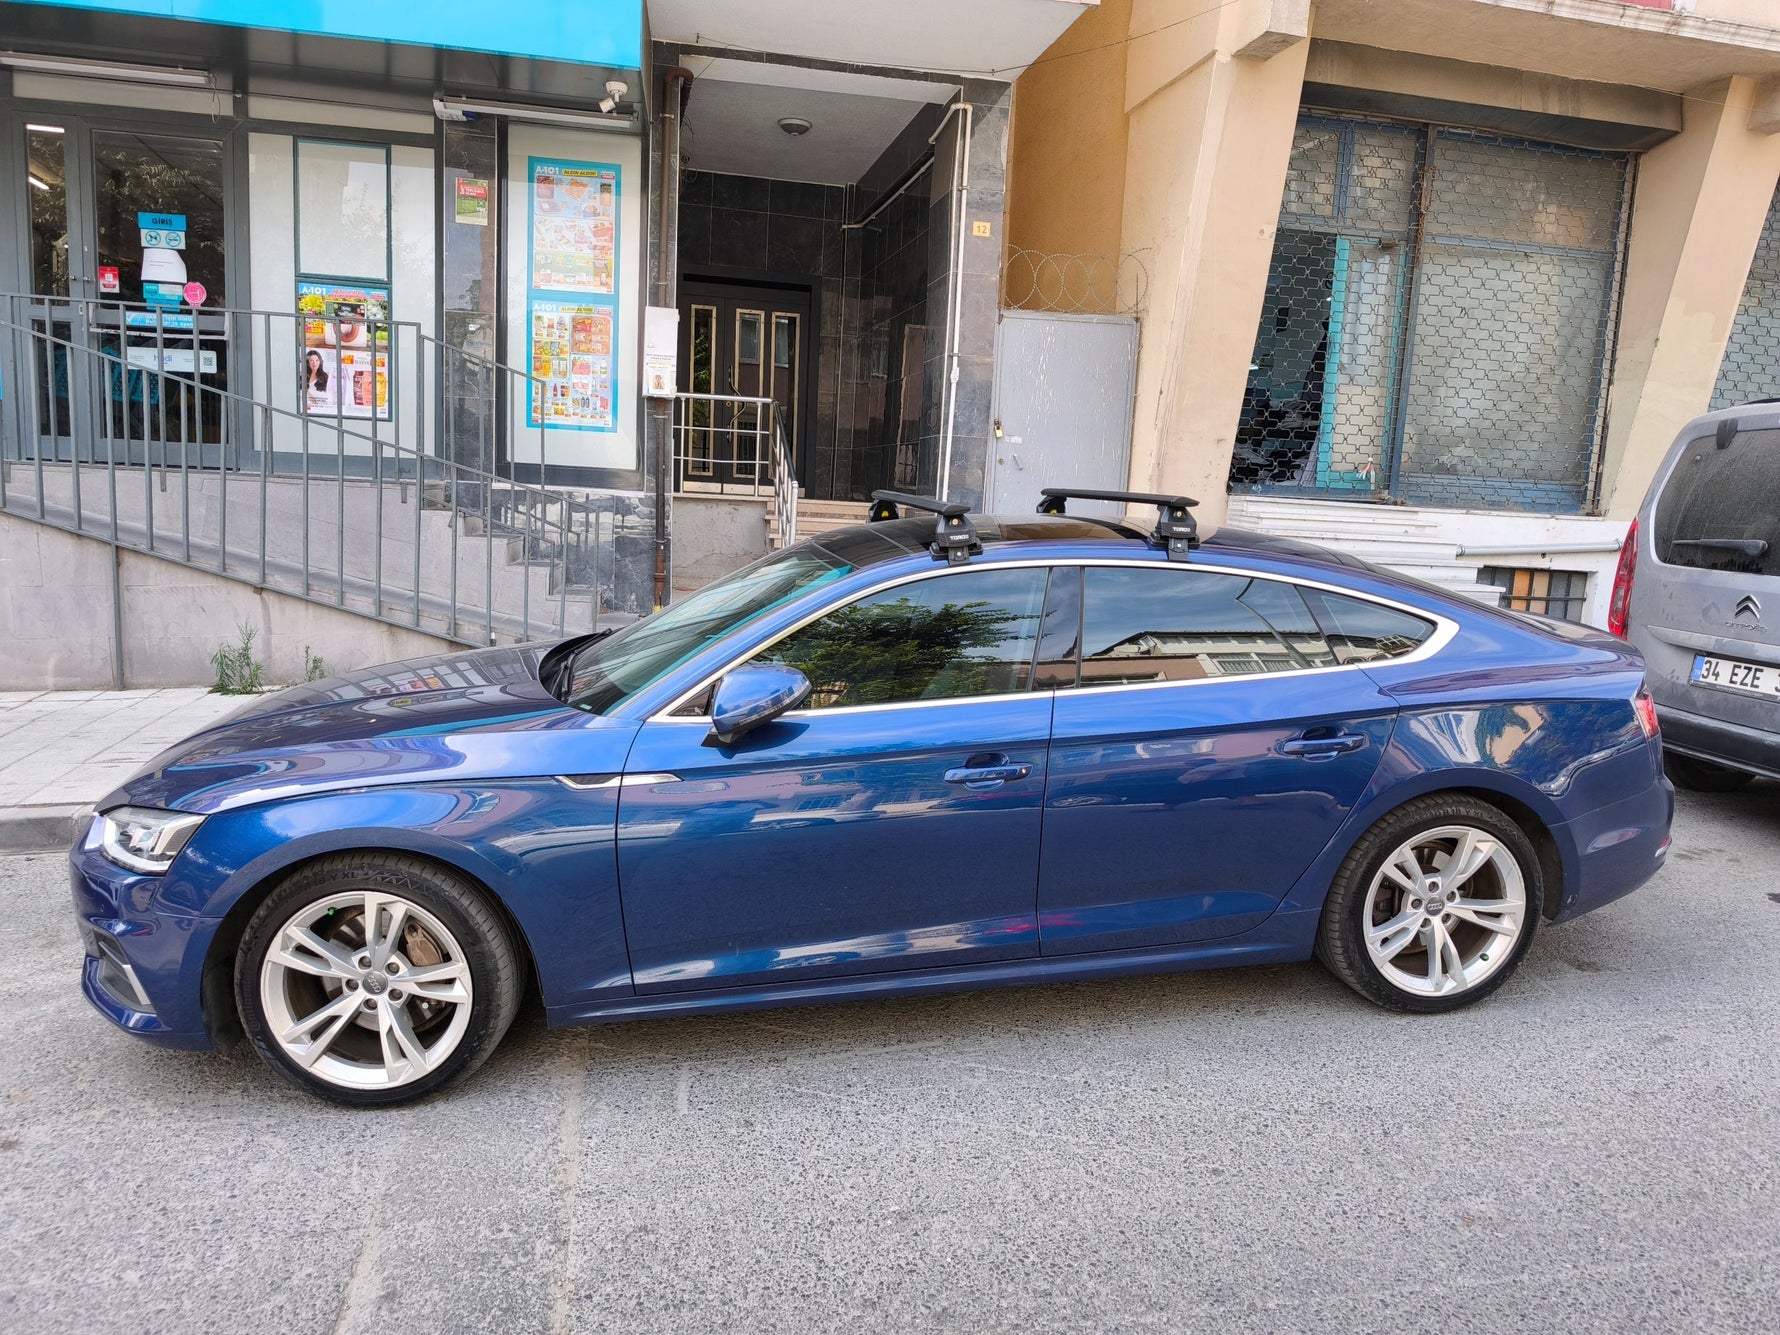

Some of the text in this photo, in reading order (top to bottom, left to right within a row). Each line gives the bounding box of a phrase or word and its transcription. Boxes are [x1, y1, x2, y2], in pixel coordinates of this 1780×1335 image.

[977, 225, 987, 234] 12
[1701, 659, 1721, 682] 34
[1729, 664, 1764, 689] EZE
